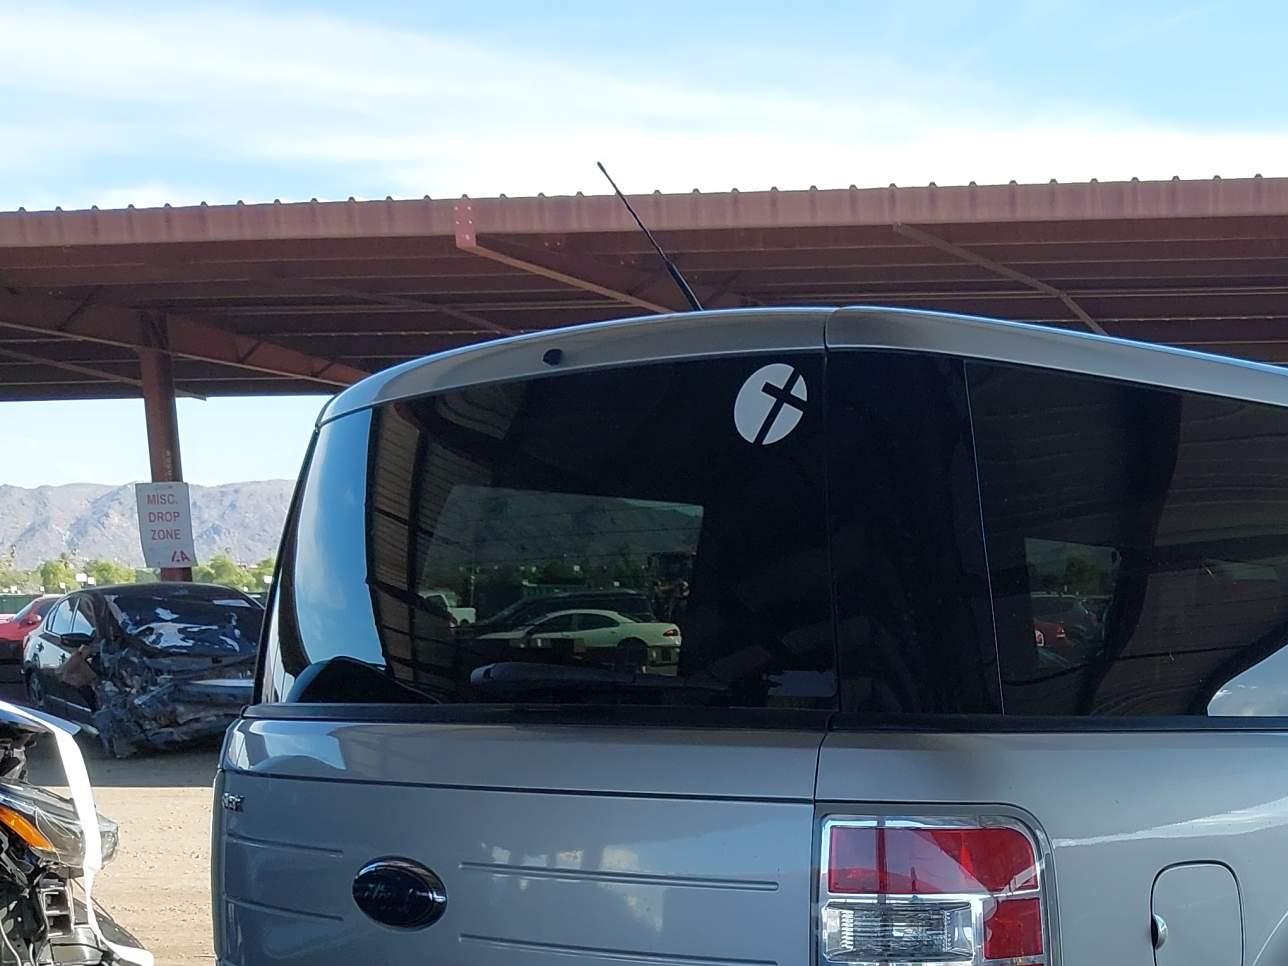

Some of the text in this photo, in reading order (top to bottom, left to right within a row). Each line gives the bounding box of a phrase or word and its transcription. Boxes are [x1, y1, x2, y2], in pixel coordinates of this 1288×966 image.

[146, 494, 179, 505] MISC.
[148, 511, 180, 523] DROP
[151, 529, 182, 541] ZONE
